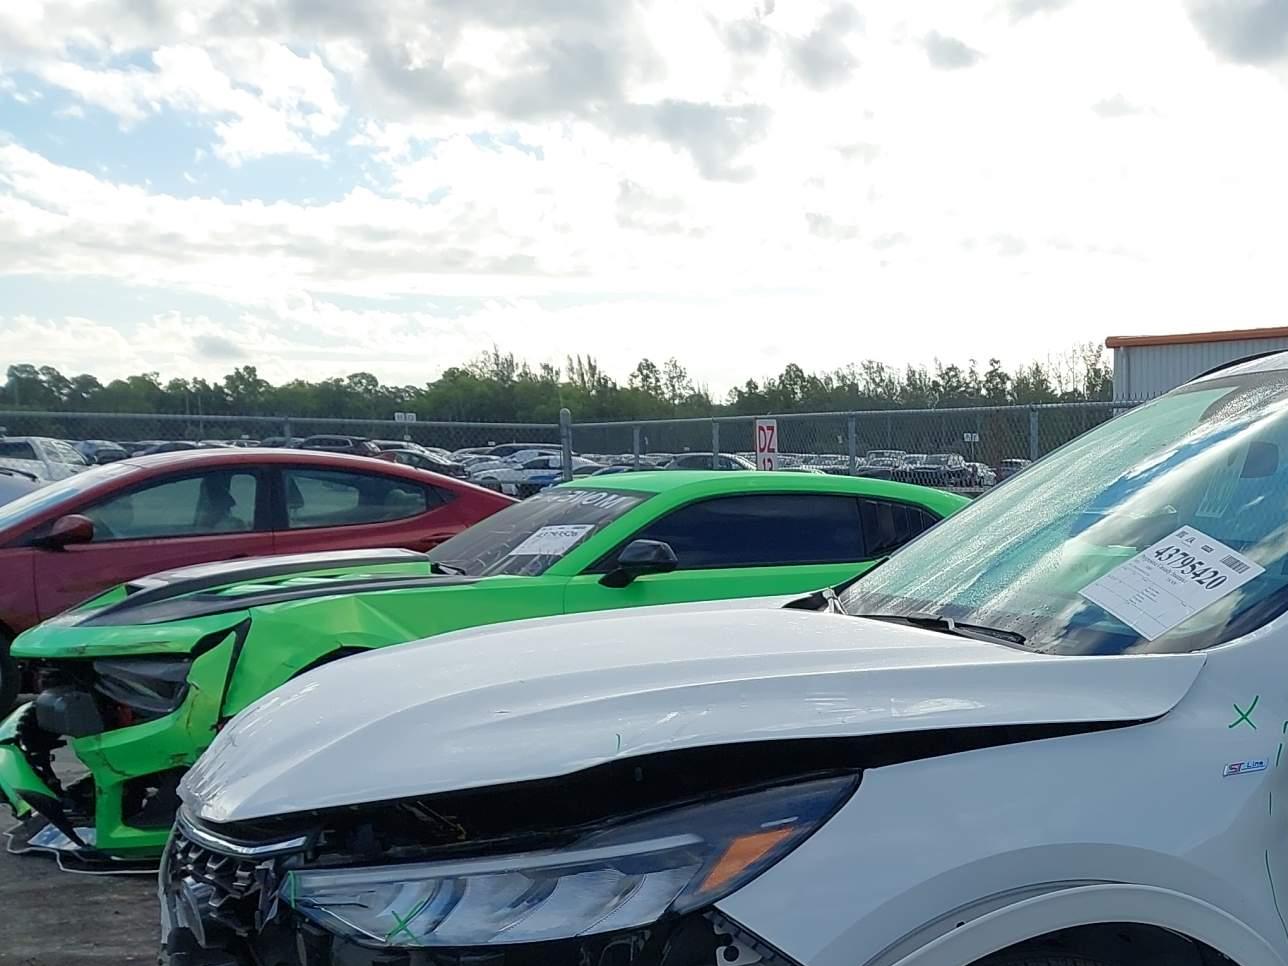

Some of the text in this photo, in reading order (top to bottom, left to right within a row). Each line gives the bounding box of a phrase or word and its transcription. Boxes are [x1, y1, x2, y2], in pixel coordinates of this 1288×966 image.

[758, 425, 775, 453] DZ
[1154, 545, 1228, 590] 43795420
[1228, 763, 1245, 774] ST
